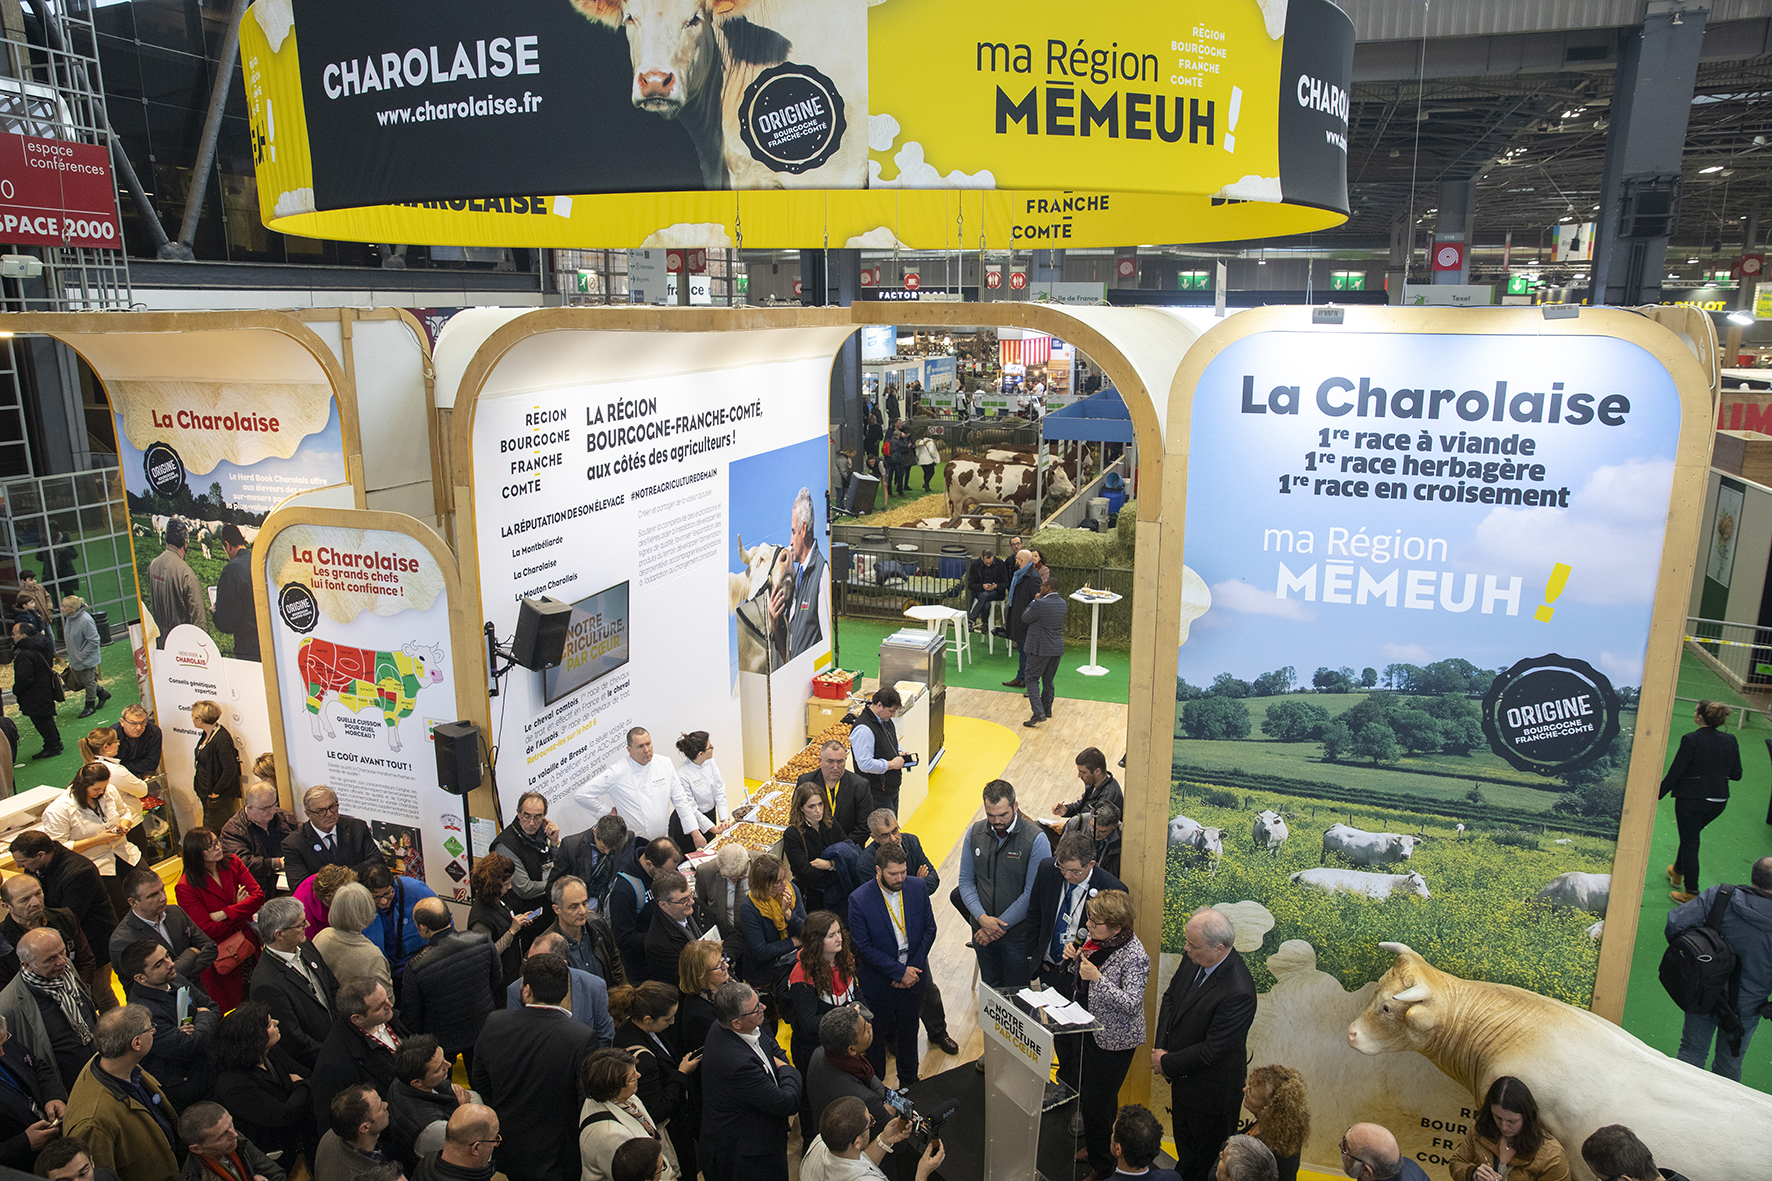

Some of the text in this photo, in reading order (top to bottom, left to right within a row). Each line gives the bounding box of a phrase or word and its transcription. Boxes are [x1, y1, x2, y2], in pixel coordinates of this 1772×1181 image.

[976, 38, 1158, 85] ma Région
[1171, 40, 1226, 58] BOURGOGNE
[323, 35, 540, 100] CHAROLAISE
[1178, 56, 1220, 74] FRANCHE
[376, 91, 542, 126] www.charolaise.fr
[758, 96, 824, 134] ORIGINE
[768, 122, 827, 148] FRANCHE-COMTÉ
[773, 118, 818, 139] BOURGOGNE
[28, 142, 73, 156] espace
[30, 156, 104, 175] conférences
[1026, 191, 1110, 214] FRANCHE
[64, 218, 114, 240] 2000
[586, 397, 657, 426] LA RÉGION
[1241, 376, 1631, 426] La Charolaise
[152, 410, 280, 432] La Charolaise
[586, 399, 763, 452] BOURGOGNE-FRANCHE-COMTÉ,
[500, 428, 570, 453] BOURGOGNE
[1354, 430, 1411, 451] race
[1417, 430, 1432, 452] à
[1440, 431, 1536, 456] viande
[151, 460, 176, 478] ORIGINE
[511, 450, 563, 475] FRANCHE
[587, 461, 611, 480] aux
[614, 452, 646, 475] côtés
[649, 447, 668, 466] des
[670, 433, 731, 464] agriculteurs
[1340, 456, 1396, 476] race
[1402, 454, 1546, 483] herbagère
[238, 473, 254, 481] Herd
[256, 474, 273, 483] Book
[274, 474, 308, 484] Charolais
[256, 484, 284, 493] éleveurs
[631, 468, 718, 501] #NOTREAGRICULTUREDEMAIN
[1314, 477, 1369, 498] race
[1374, 482, 1407, 500] en
[1413, 481, 1570, 508] croisement
[501, 526, 513, 538] LA
[514, 511, 566, 534] RÉPUTATION
[595, 494, 624, 512] ÉLEVAGE
[512, 536, 563, 557] La Montbéliarde
[1264, 527, 1448, 564] ma Région
[292, 545, 419, 573] La Charolaise
[514, 559, 557, 580] La Charolaise
[311, 578, 323, 588] lui
[325, 579, 346, 591] font
[347, 582, 398, 596] confiance
[313, 566, 399, 583] Les grands chefs
[515, 572, 578, 601] Le Mouton Charollais
[286, 598, 310, 613] ORIGINE
[567, 613, 602, 641] NOTRE
[176, 656, 206, 665] CHAROLAIS
[567, 634, 620, 672] PAR CŒUR
[169, 677, 216, 689] Conseils génétiques
[582, 698, 599, 712] France
[614, 679, 630, 694] cheval
[524, 724, 532, 733] Le
[534, 710, 554, 728] cheval
[556, 698, 579, 715] comtois
[601, 682, 608, 690] de
[1506, 694, 1594, 728] ORIGINE
[173, 727, 197, 735] Neutralité
[337, 716, 382, 728] QUELLE CUISSON
[345, 730, 370, 738] MORCEAU
[360, 725, 375, 733] QUEL
[1515, 723, 1594, 744] FRANCHE-COMTÉ
[1523, 719, 1582, 736] BOURGOGNE
[526, 746, 534, 755] de
[536, 731, 558, 749] l'Auxois
[527, 739, 566, 765] Retrouvez-les
[567, 732, 576, 742] sur
[582, 722, 592, 733] hall
[337, 752, 358, 762] GOÛT
[360, 757, 385, 767] AVANT
[386, 760, 407, 770] TOUT
[528, 776, 536, 786] La
[538, 762, 559, 779] volaille
[560, 756, 567, 766] de
[569, 744, 588, 760] Bresse
[995, 1003, 1024, 1032] NOTRE
[984, 1005, 1041, 1056] AGRICULTURE
[995, 1022, 1038, 1064] PAR CŒUR
[1421, 1118, 1467, 1135] BOUR
